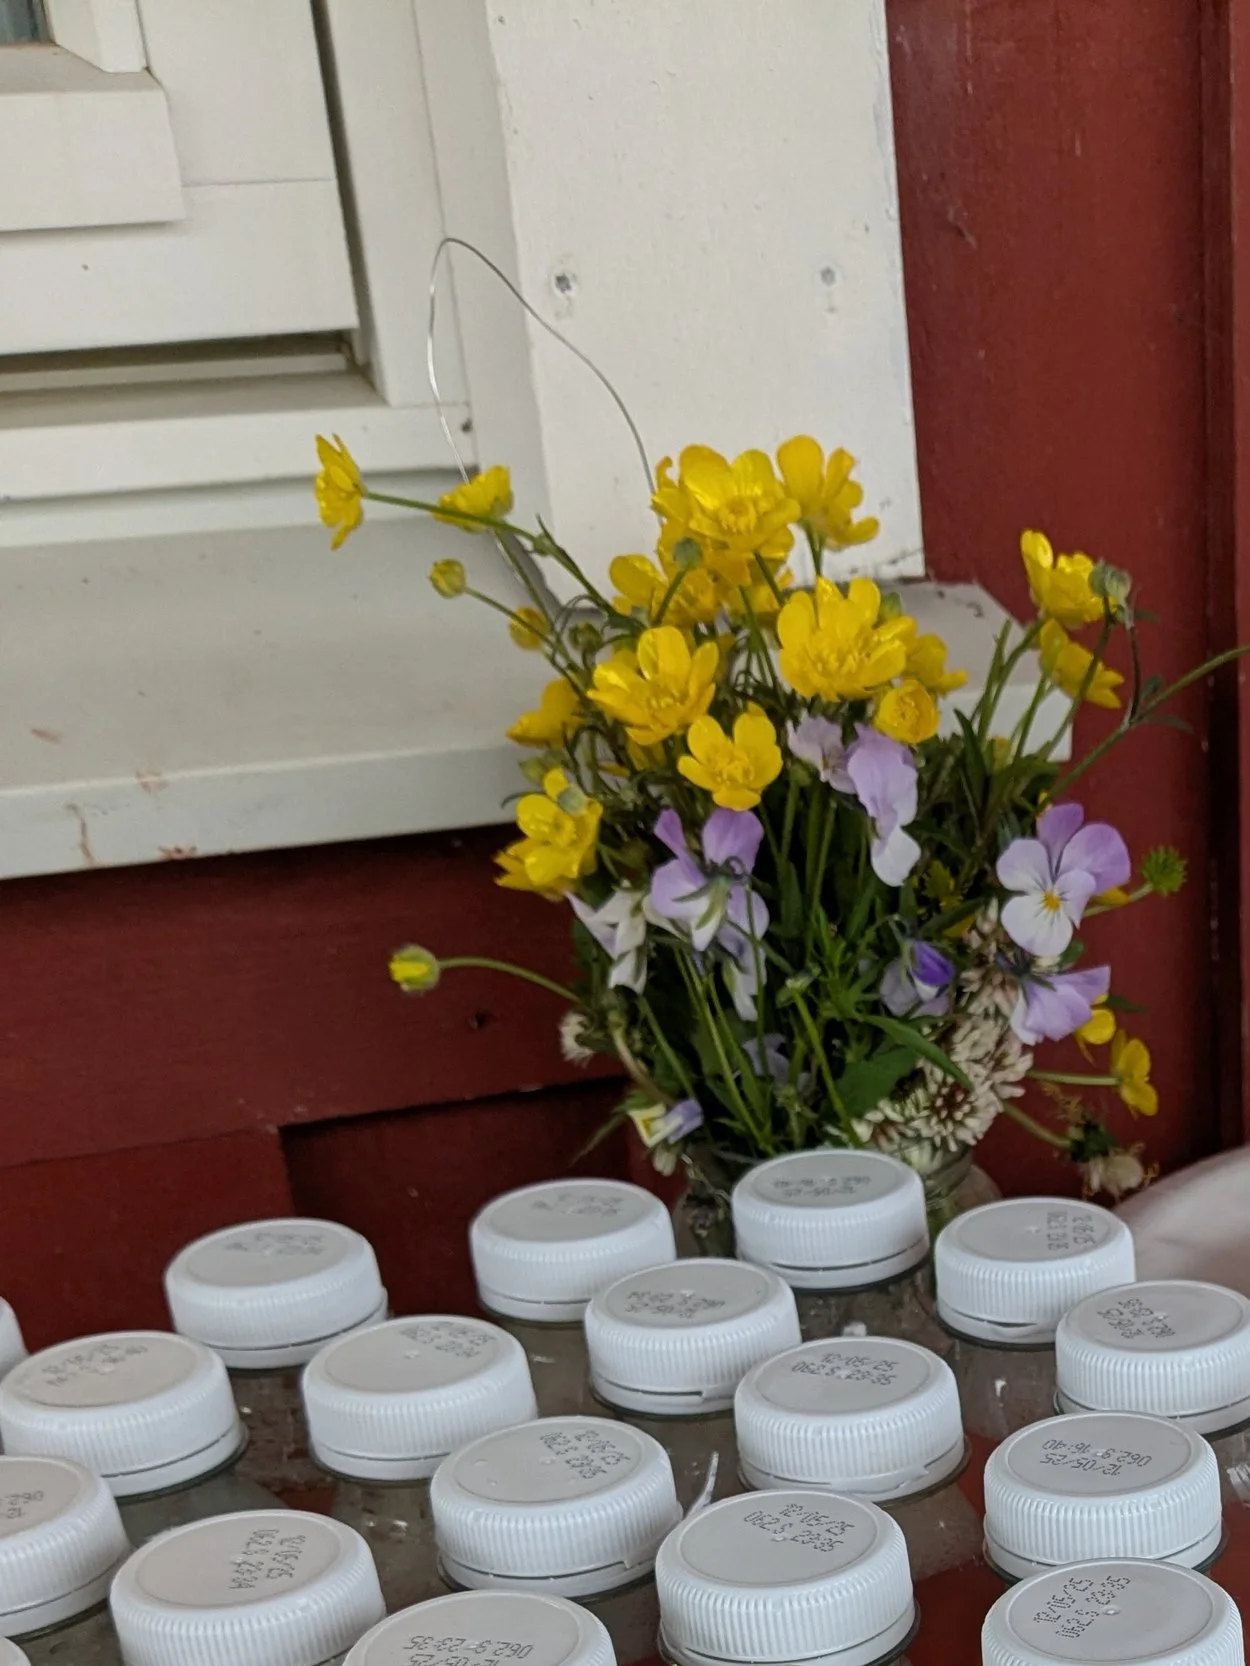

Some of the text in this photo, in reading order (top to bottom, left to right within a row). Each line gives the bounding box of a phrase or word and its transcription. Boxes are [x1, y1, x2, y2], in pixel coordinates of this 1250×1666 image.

[1042, 1440, 1090, 1453] 16:40
[1040, 1453, 1121, 1476] 12/05/25
[780, 1504, 854, 1536] 12/05/25
[1033, 1577, 1093, 1622] 12/05/25
[1086, 1575, 1130, 1605] 23:35
[402, 1635, 467, 1653] 23:35
